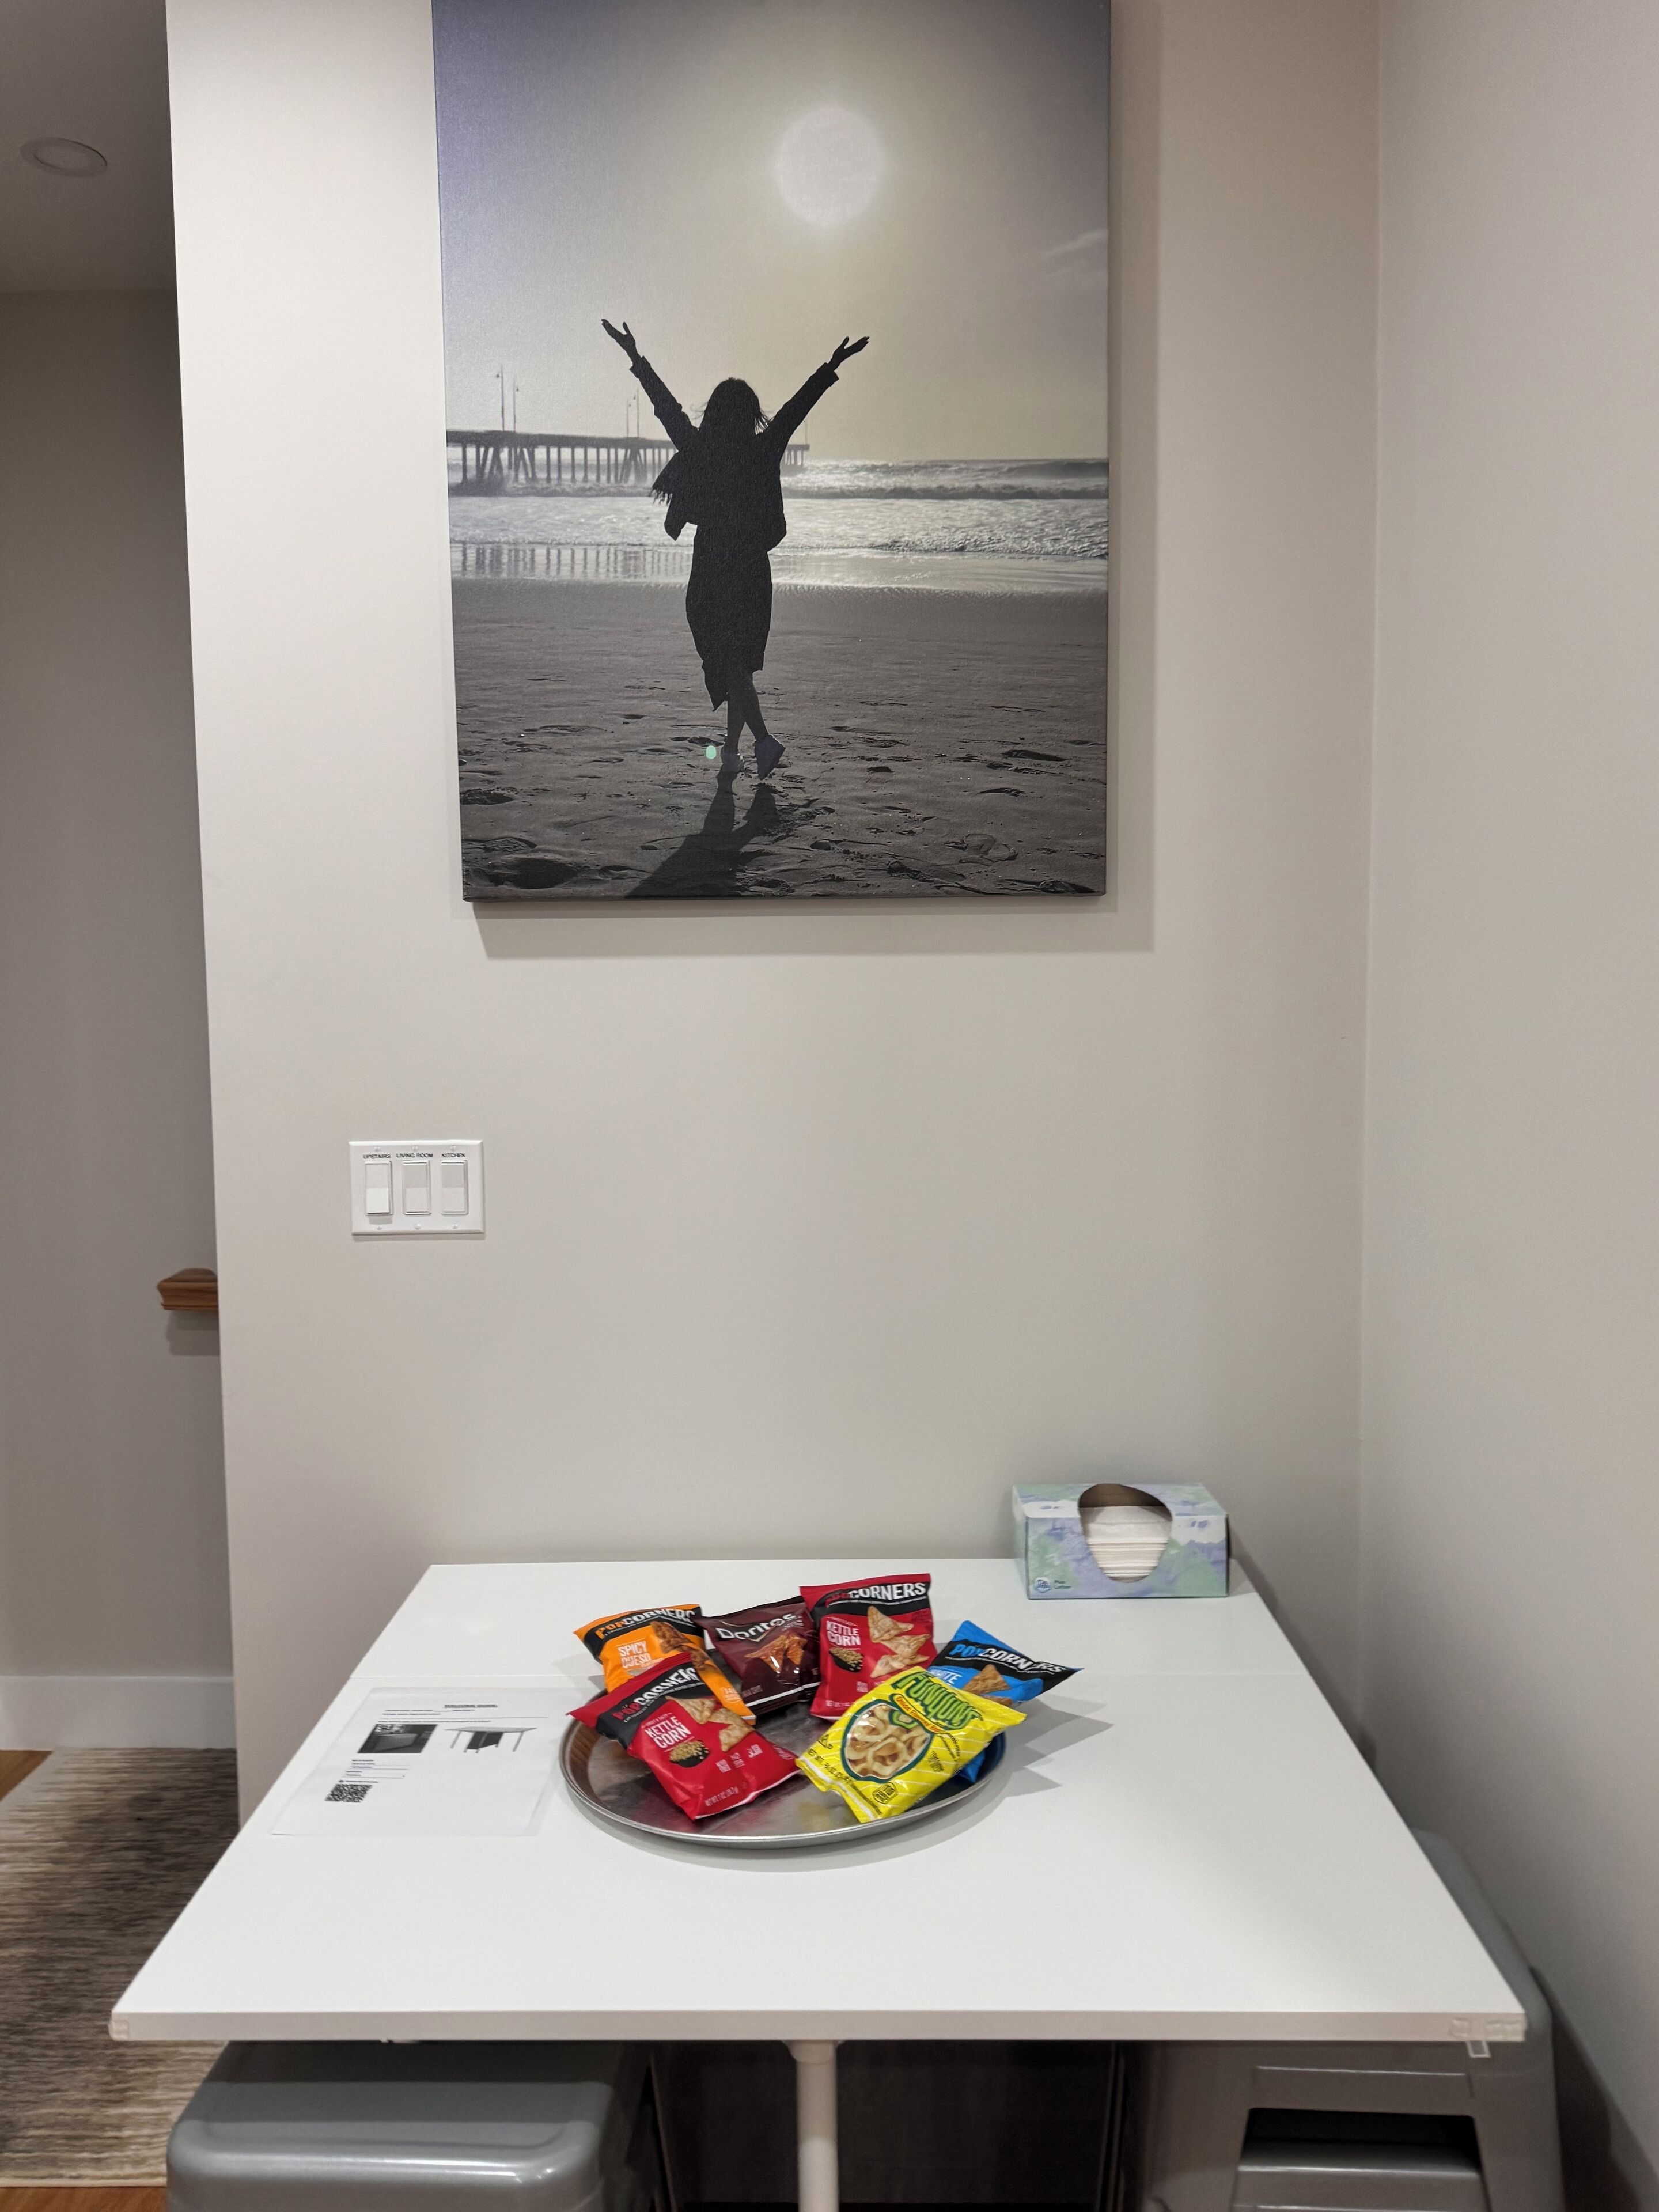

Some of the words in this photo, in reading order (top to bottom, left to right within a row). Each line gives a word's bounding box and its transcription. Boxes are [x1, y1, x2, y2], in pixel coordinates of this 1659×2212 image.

[715, 1613, 797, 1640] Doritos
[826, 1620, 859, 1636] KETTLE
[827, 1631, 861, 1646] CORN
[618, 1641, 647, 1657] SPICY
[621, 1653, 652, 1669] QUESO
[645, 1715, 682, 1738] KETTLE
[653, 1725, 692, 1748] CORN
